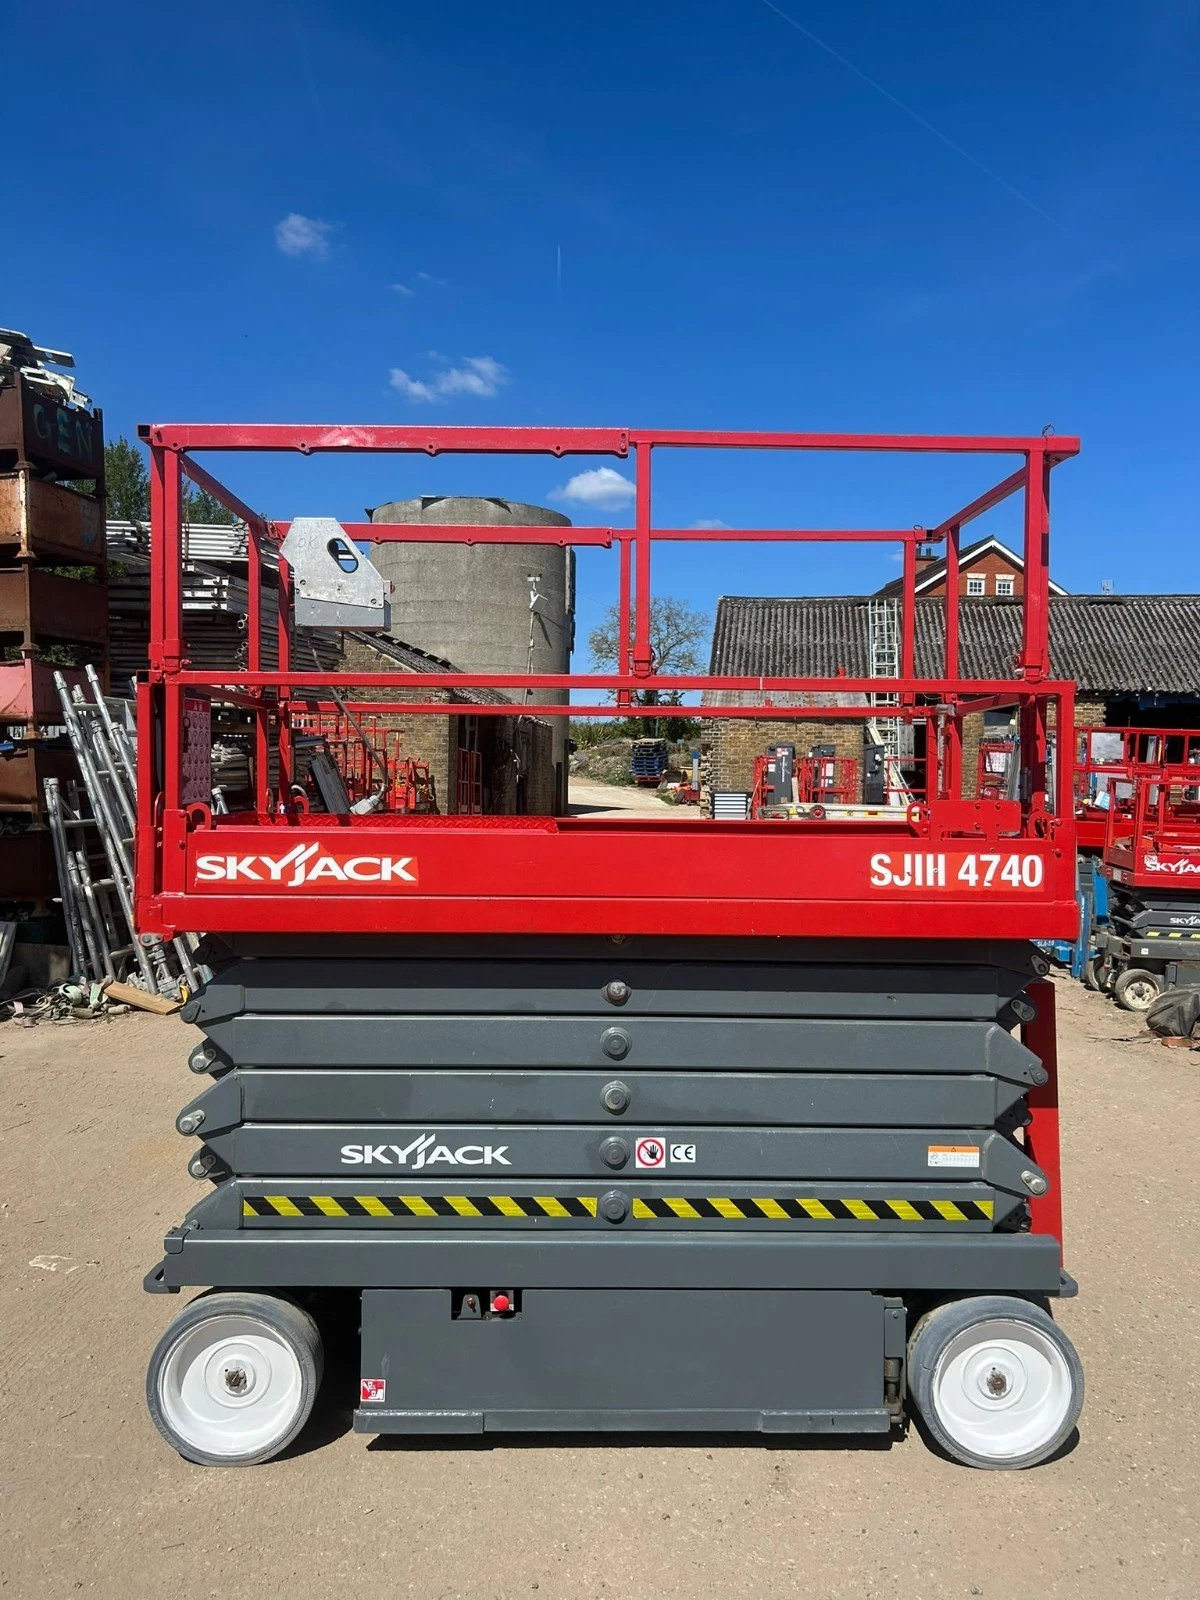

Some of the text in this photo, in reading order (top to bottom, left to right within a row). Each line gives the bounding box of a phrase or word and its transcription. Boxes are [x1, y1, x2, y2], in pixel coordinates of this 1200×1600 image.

[196, 841, 418, 887] SKYJACK
[957, 854, 1043, 887] 4740
[1145, 858, 1200, 875] SKYJA
[340, 1132, 512, 1170] SKYJACK
[672, 1145, 694, 1160] CE
